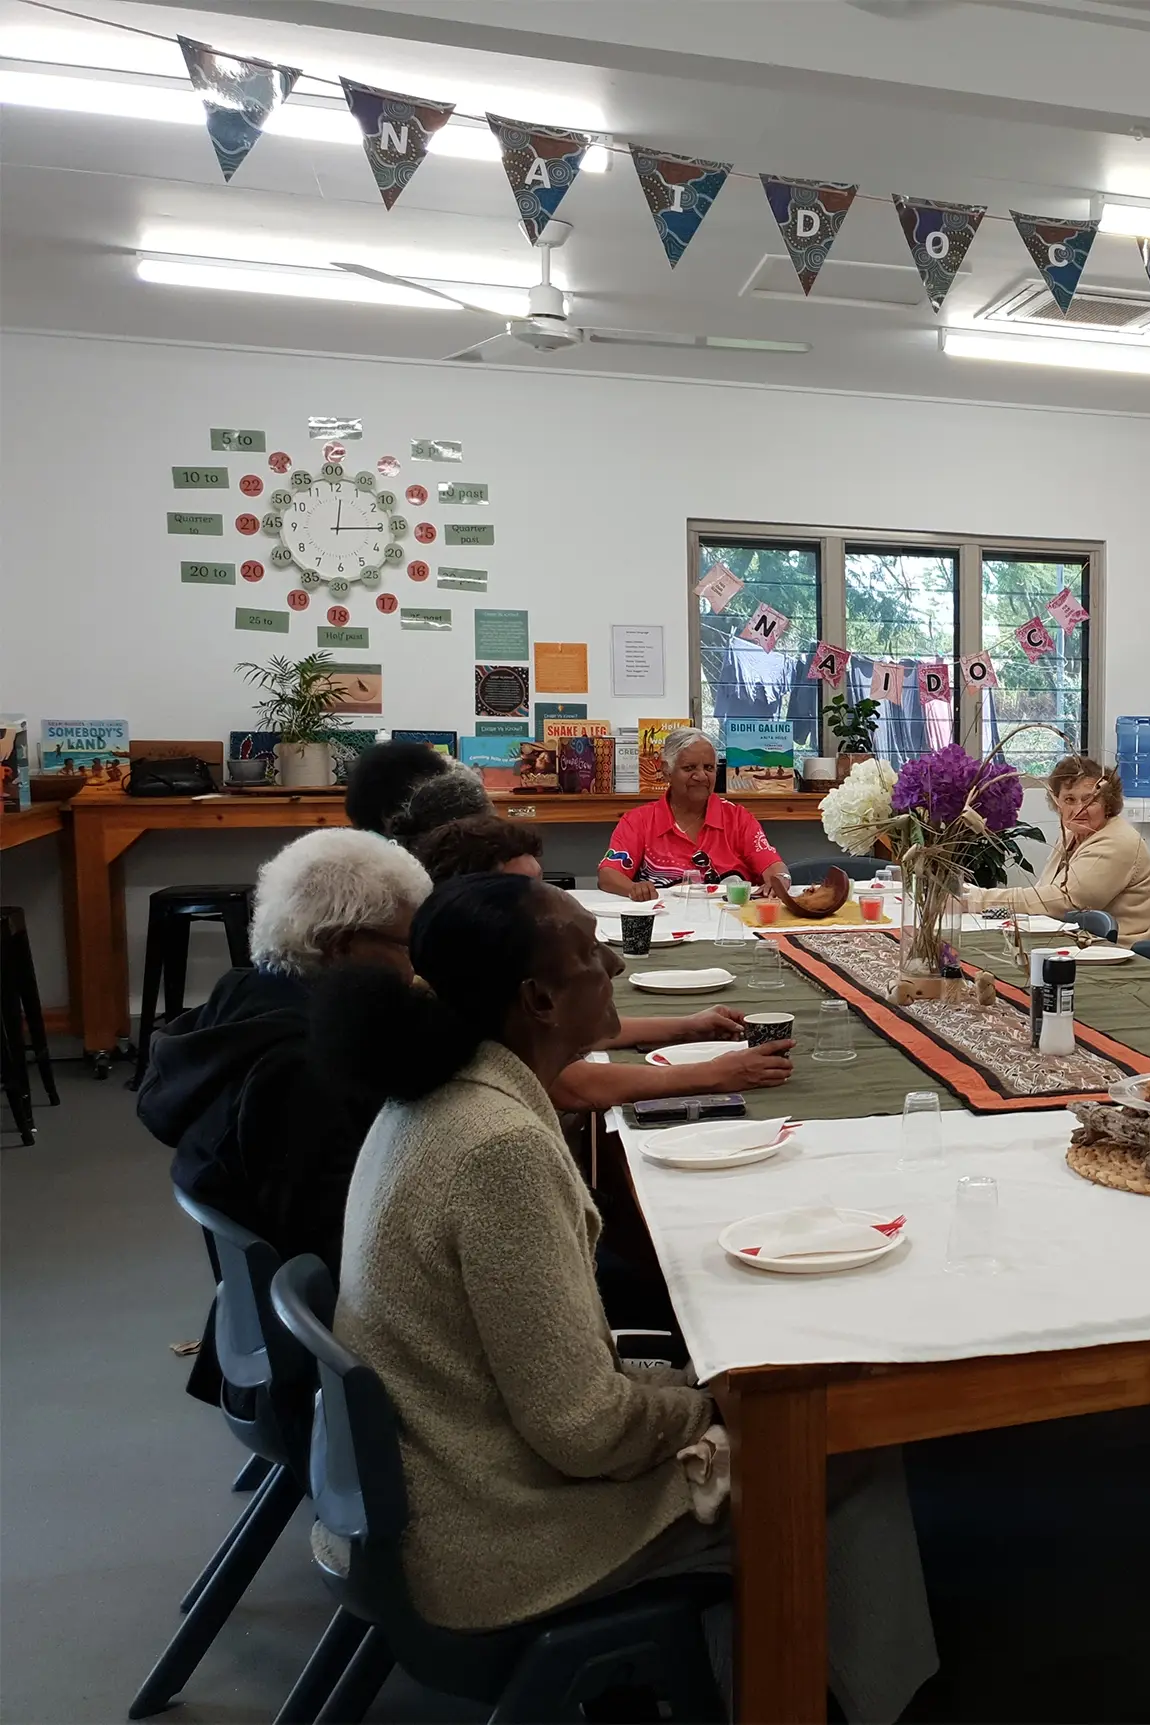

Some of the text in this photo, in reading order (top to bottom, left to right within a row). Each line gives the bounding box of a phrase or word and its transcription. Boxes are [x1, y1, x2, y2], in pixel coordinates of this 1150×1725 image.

[222, 431, 253, 446] 5 to
[183, 471, 219, 483] 10 to
[242, 479, 261, 492] 22
[329, 482, 342, 493] 12
[308, 488, 319, 497] 11
[458, 489, 484, 501] past
[293, 502, 306, 512] 10
[370, 503, 377, 513] 2
[174, 514, 214, 524] Quarter
[240, 516, 257, 530] 21
[291, 521, 298, 532] 9
[452, 524, 487, 533] Quarter
[419, 526, 434, 539] 15
[461, 536, 480, 545] past
[298, 542, 305, 552] 8
[373, 542, 380, 552] 4
[315, 557, 322, 567] 7
[338, 562, 344, 572] 6
[359, 557, 366, 566] 5
[190, 566, 227, 578] 20 to
[241, 563, 264, 578] 20
[410, 565, 425, 577] 16
[290, 594, 308, 606] 19
[379, 597, 395, 610] 17
[249, 615, 273, 626] 25 to
[331, 609, 348, 622] 18
[48, 727, 124, 738] SOMEBODY'S
[547, 725, 578, 736] SHAKE
[730, 723, 791, 733] BIDHI GALING
[67, 739, 107, 750] LAND
